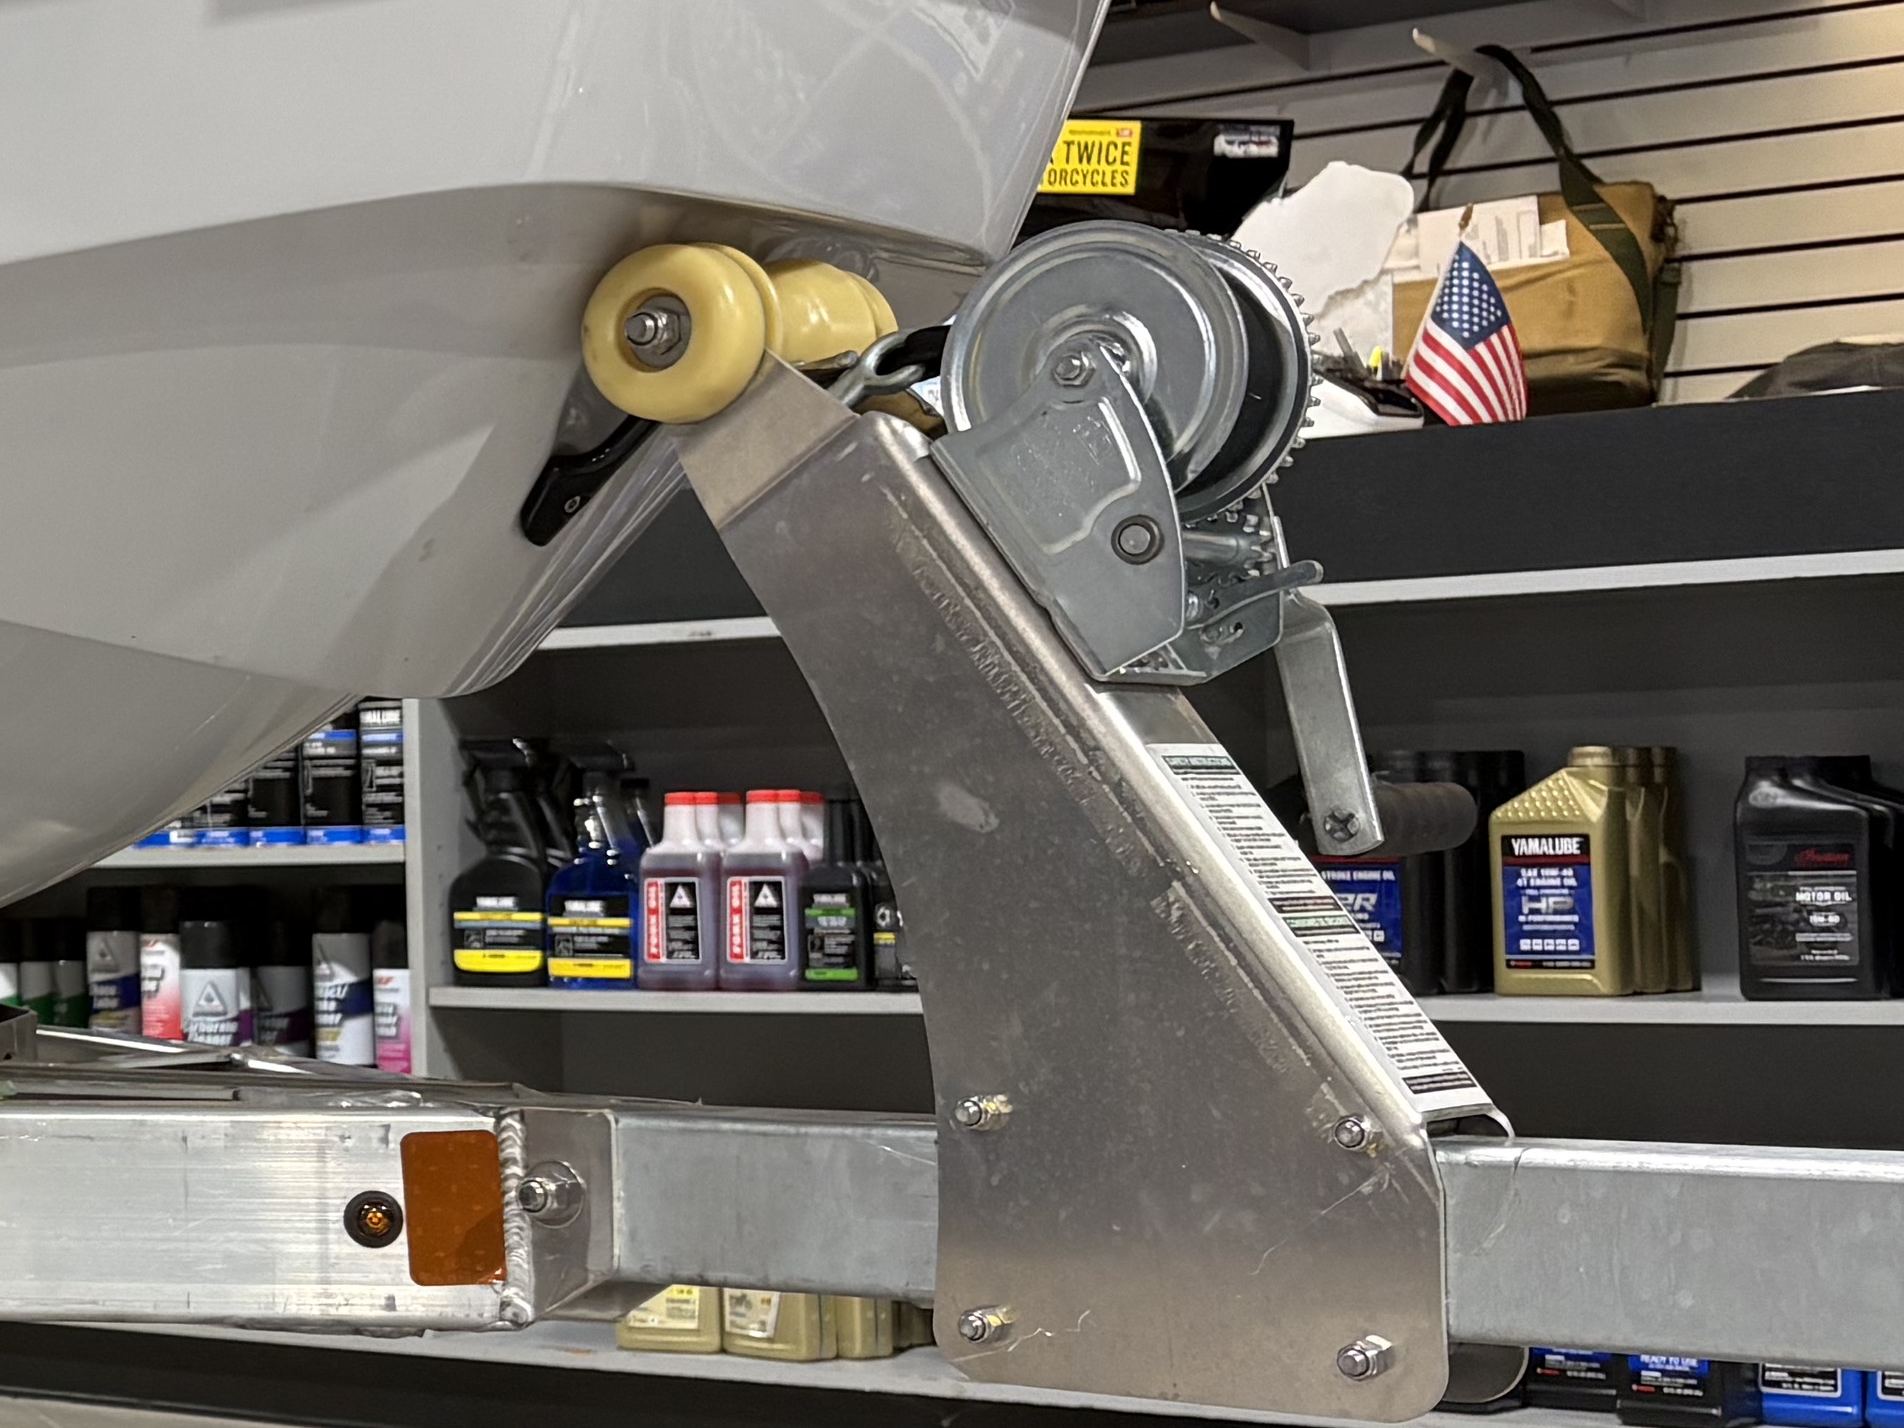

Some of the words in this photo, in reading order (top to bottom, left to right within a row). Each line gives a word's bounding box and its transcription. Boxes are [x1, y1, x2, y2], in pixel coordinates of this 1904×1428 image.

[1063, 140, 1132, 166] TWICE
[1511, 837, 1582, 856] YAMALUBE
[1521, 895, 1575, 914] HP
[1795, 891, 1831, 901] MOTOR
[1834, 891, 1853, 901] OIL
